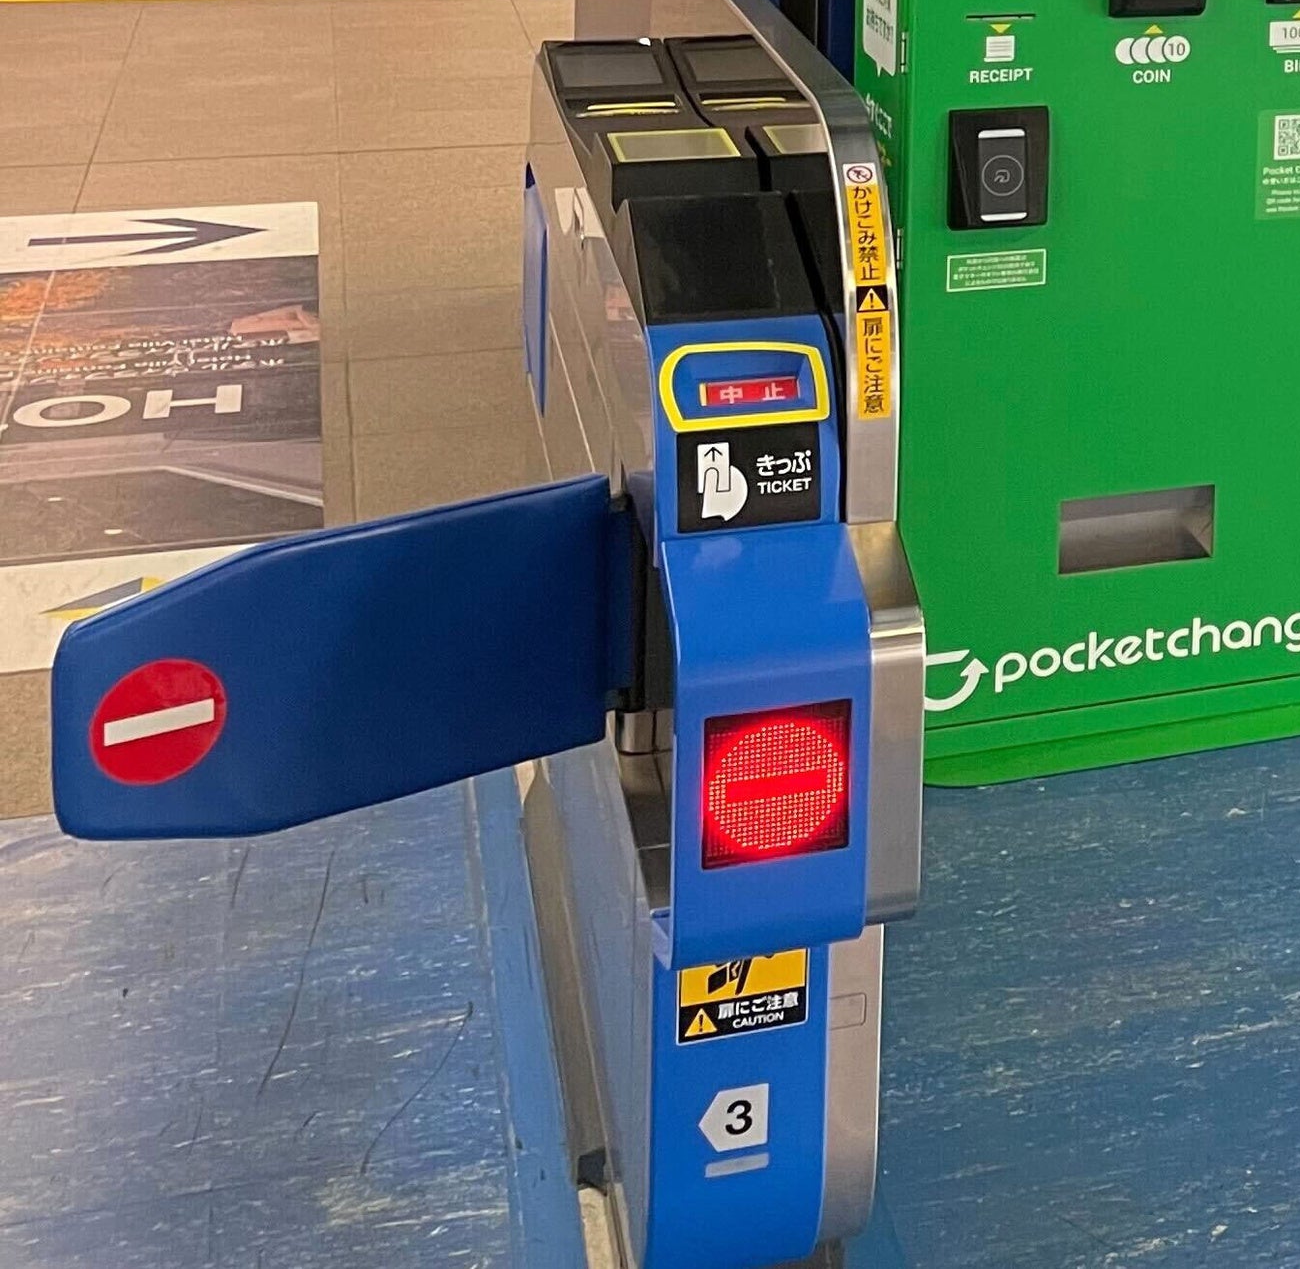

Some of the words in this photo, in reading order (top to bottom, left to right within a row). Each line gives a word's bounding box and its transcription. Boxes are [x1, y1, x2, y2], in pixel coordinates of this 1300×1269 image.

[1167, 42, 1186, 57] 10
[969, 67, 1033, 84] RECEIPT
[1132, 69, 1171, 84] COIN
[851, 185, 883, 282] かけこみ禁止
[861, 316, 885, 415] 扉にご注意
[0, 383, 243, 430] HO
[718, 383, 786, 407] 中止
[755, 448, 813, 477] きっぷ
[757, 477, 812, 495] TICKET
[717, 990, 799, 1021] 扉にご注意
[732, 1010, 785, 1030] CAUTION
[725, 1097, 753, 1137] 3
